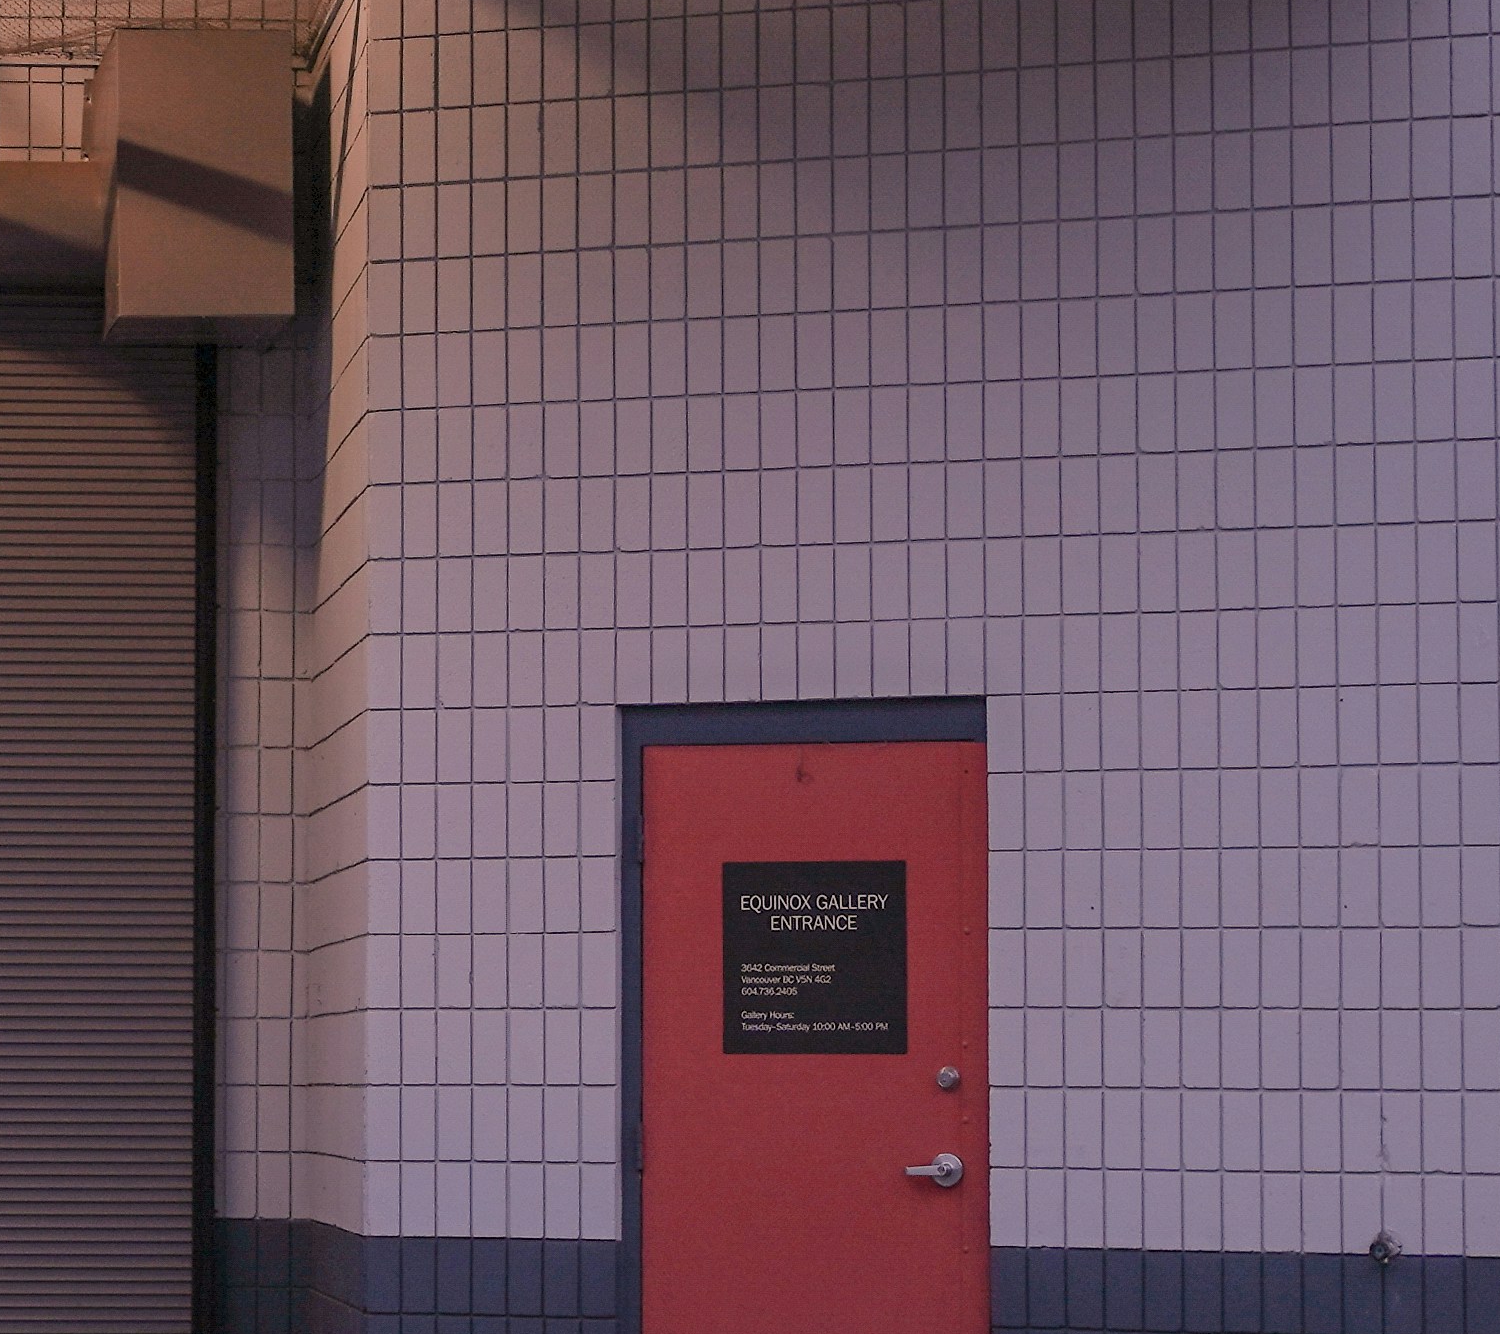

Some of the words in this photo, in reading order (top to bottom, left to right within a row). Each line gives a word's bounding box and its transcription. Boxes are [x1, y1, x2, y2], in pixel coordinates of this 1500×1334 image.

[740, 894, 812, 914] EQUINOX
[815, 893, 889, 911] GALLERY
[770, 914, 858, 931] ENTRANCE
[740, 963, 763, 973] 3642
[764, 963, 810, 973] Commercial
[811, 963, 836, 973] Street
[741, 975, 781, 985] Vancouver
[782, 975, 795, 985] BC
[796, 975, 813, 985] V5N
[741, 1010, 768, 1021] Gallery
[769, 1010, 795, 1020] Hours:
[812, 1021, 836, 1031] 10:00
[875, 1021, 889, 1031] PM
